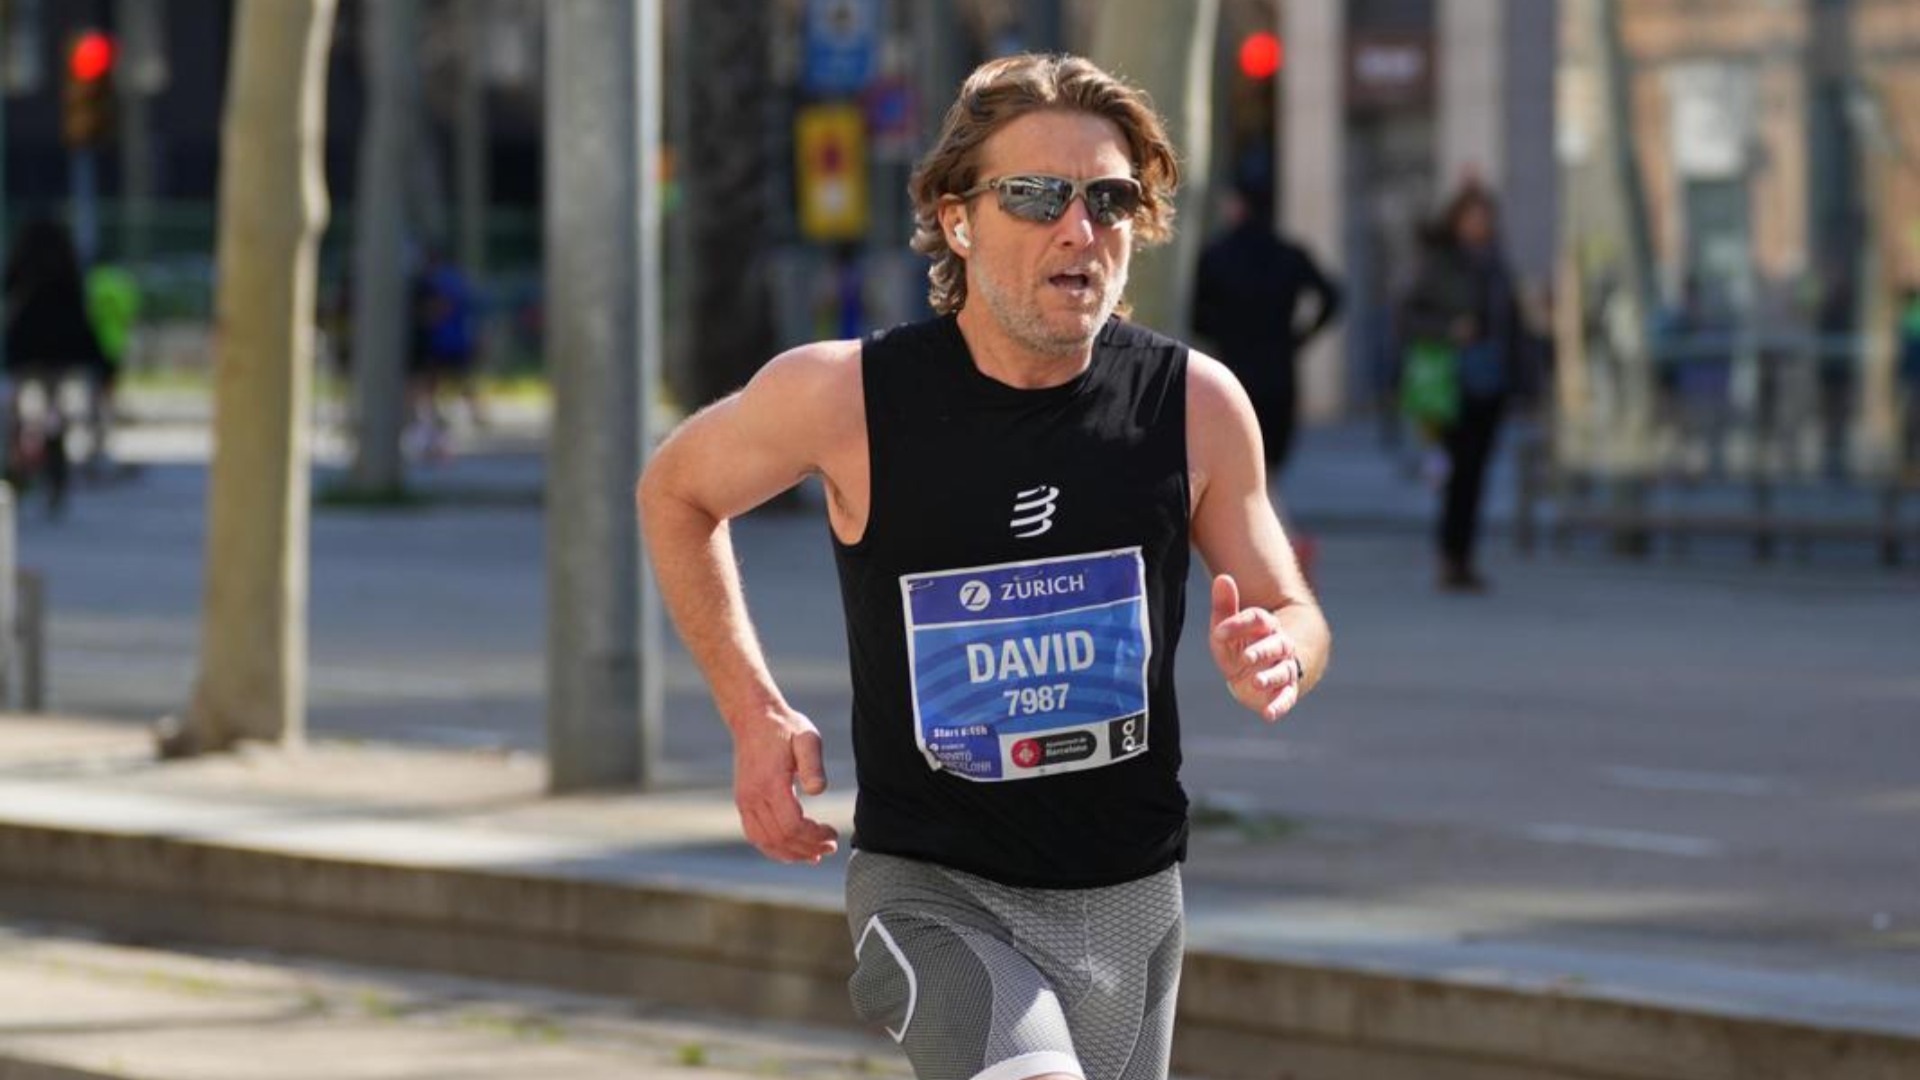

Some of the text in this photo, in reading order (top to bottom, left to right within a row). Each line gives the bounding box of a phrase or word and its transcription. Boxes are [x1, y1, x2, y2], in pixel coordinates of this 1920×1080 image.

[1000, 574, 1085, 601] ZURICH
[967, 630, 1096, 684] DAVID
[1003, 684, 1070, 716] 7987
[934, 727, 959, 738] Start
[1046, 745, 1088, 757] Barcelona
